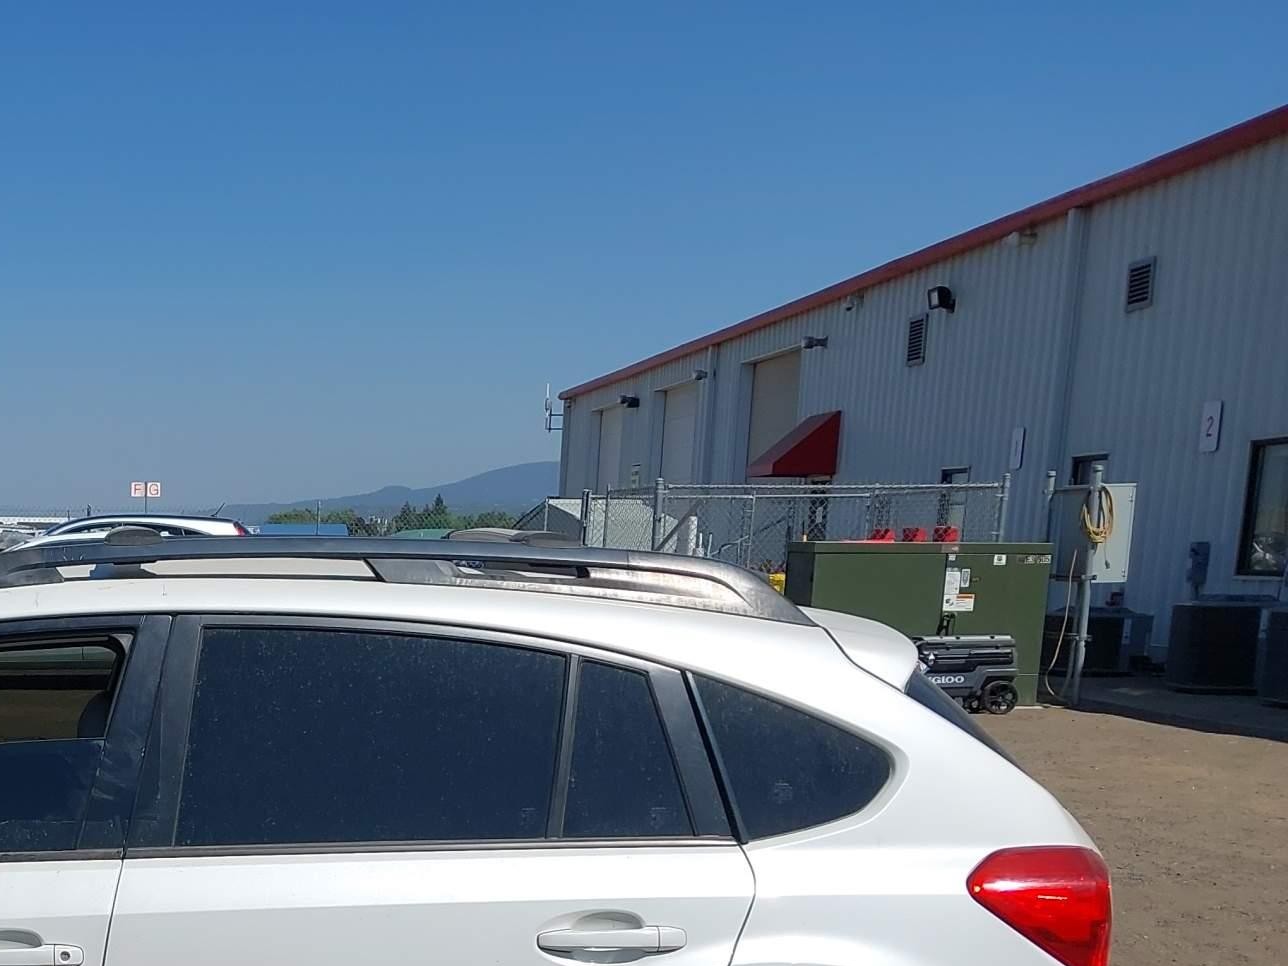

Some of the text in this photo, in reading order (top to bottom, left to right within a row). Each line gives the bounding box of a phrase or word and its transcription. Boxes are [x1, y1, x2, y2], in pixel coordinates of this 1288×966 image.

[1205, 415, 1215, 437] 2
[133, 483, 142, 496] F
[148, 483, 159, 496] G
